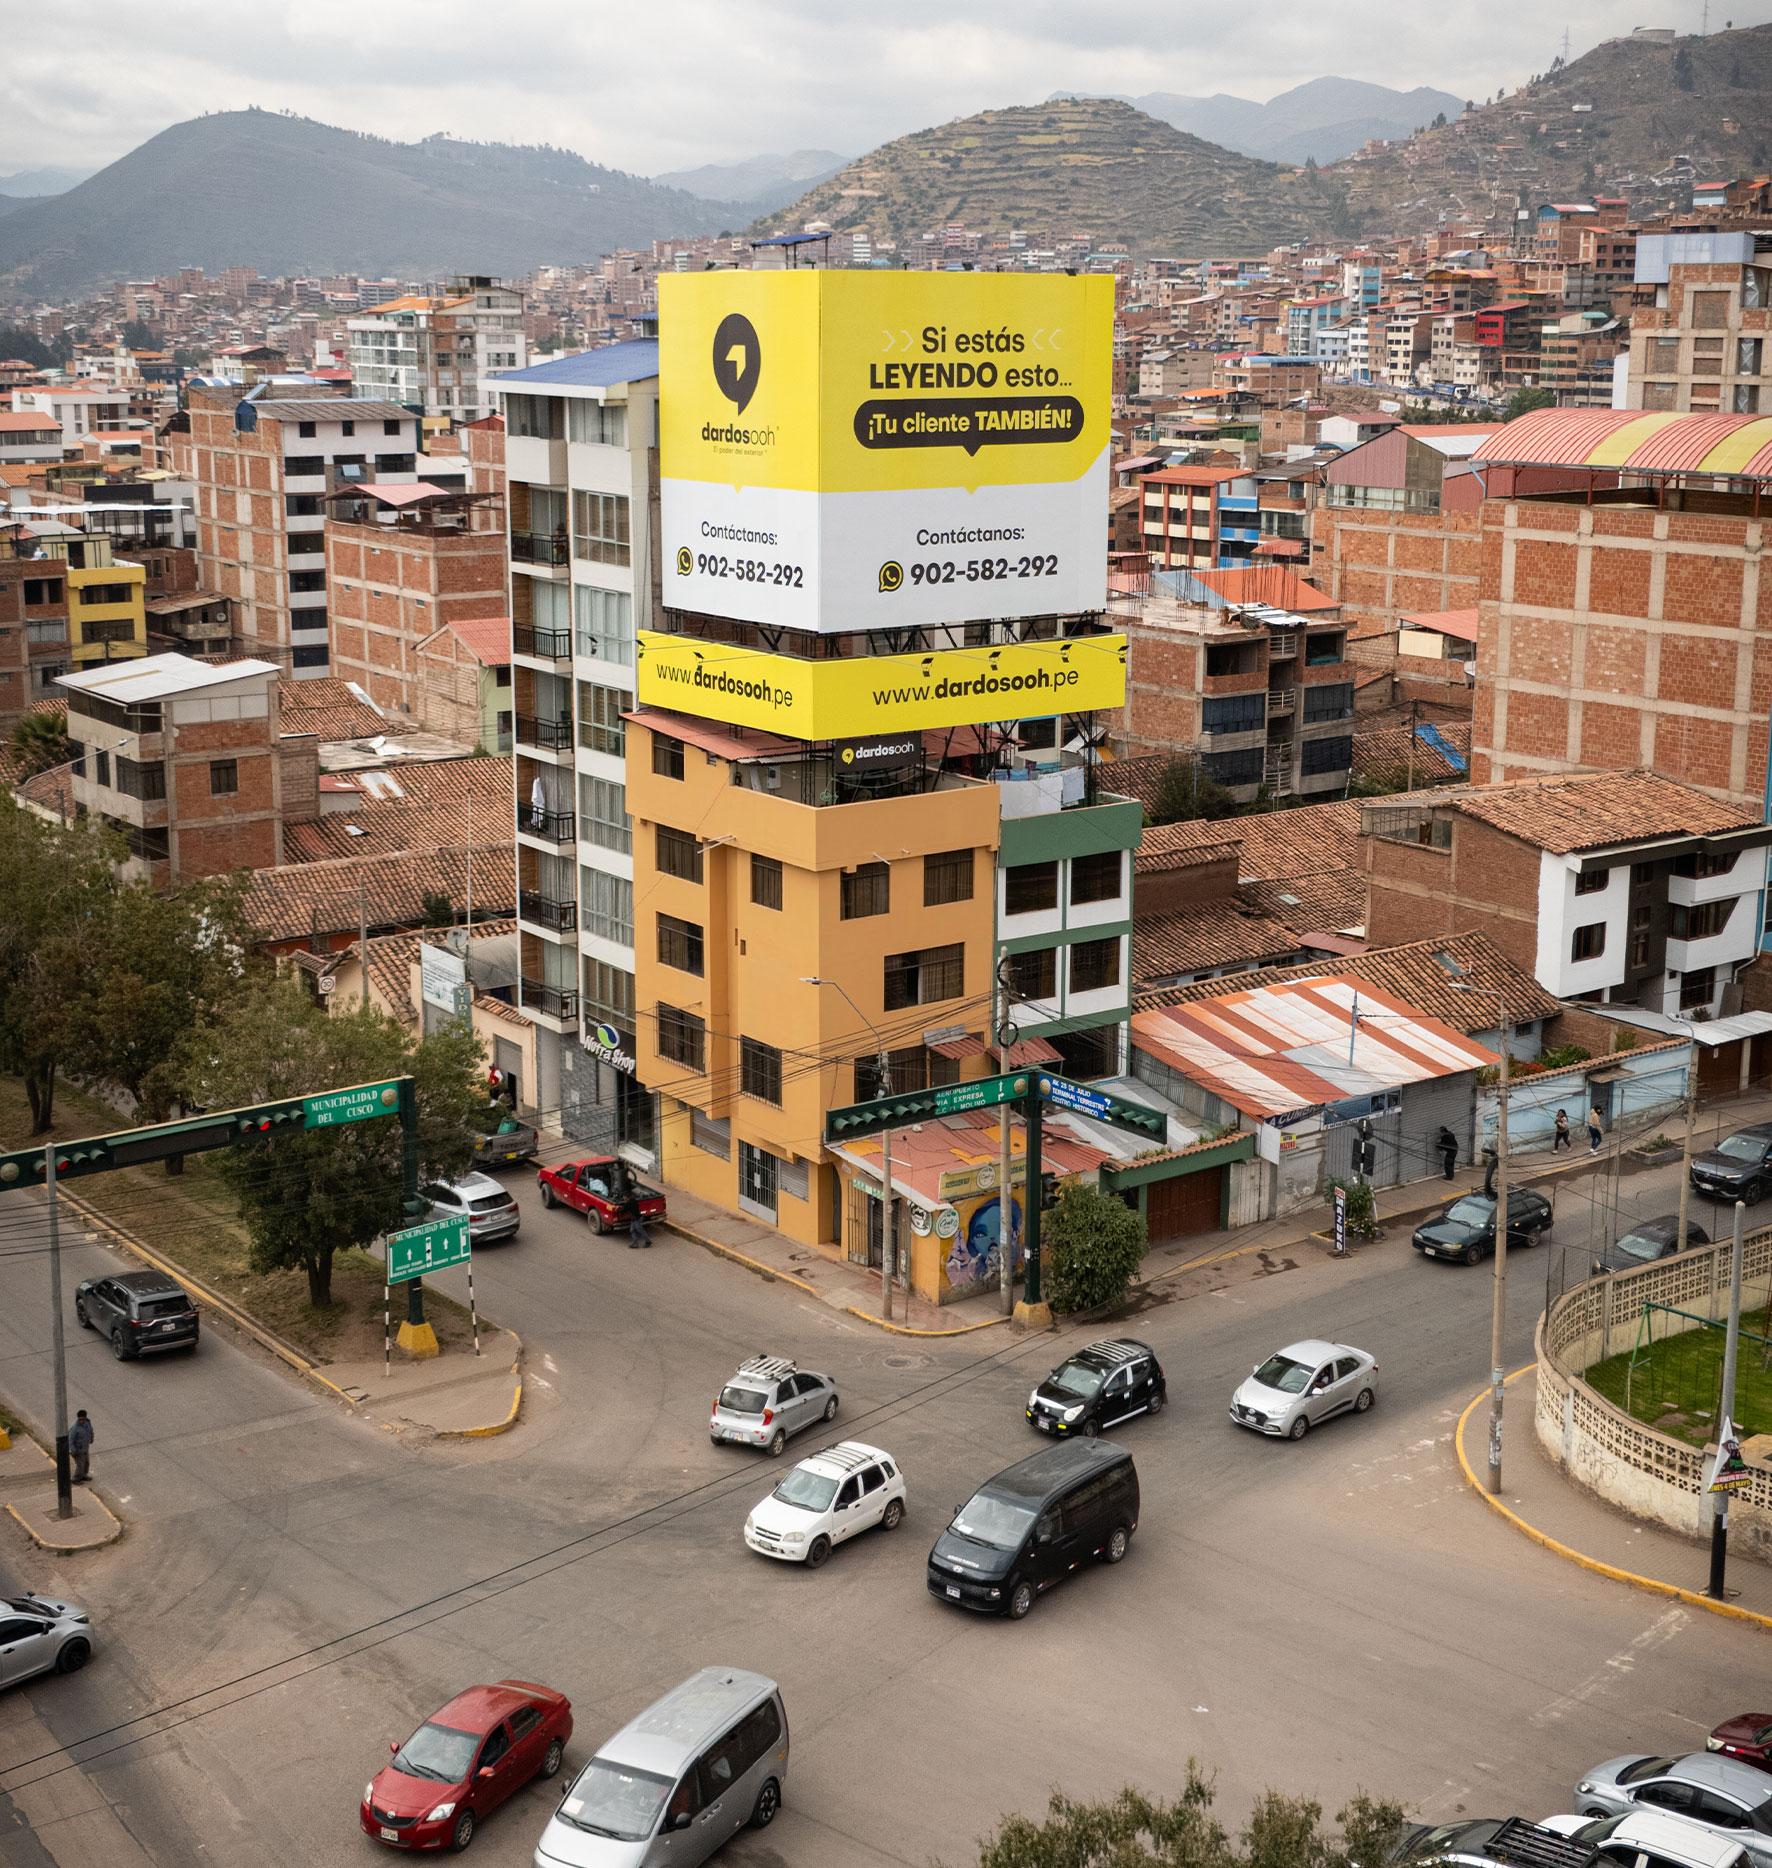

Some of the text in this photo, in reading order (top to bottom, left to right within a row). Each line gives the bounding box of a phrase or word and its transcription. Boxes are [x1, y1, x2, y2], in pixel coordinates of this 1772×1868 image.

[922, 326, 1025, 353] Si estás
[870, 362, 1072, 389] LEYENDO esto...
[701, 421, 775, 446] dardosooh
[868, 403, 1072, 440] ¡Tu cliente TAMBIÉN!
[713, 445, 719, 453] El
[701, 520, 778, 545] Contáctanos:
[916, 526, 1025, 546] Contáctanos:
[697, 553, 803, 588] 902-582-292
[910, 554, 1058, 586] 902-582-292
[656, 663, 793, 709] www.dardosooh.pe
[872, 668, 1079, 705] www.dardosooh.pe
[855, 741, 914, 759] dardosooh
[584, 1035, 612, 1060] Nutra
[612, 1049, 636, 1074] Shop
[311, 1090, 378, 1112] MUNICIPALIDAD
[936, 1084, 980, 1098] AEROPUERTO
[953, 1092, 984, 1103] EXPRESA
[1052, 1087, 1105, 1111] TERMINAL TERRESTRE
[1068, 1084, 1075, 1092] DE
[1076, 1087, 1091, 1098] JULIO
[318, 1104, 374, 1124] DEL CUSCO
[960, 1099, 986, 1110] MOLINO
[1051, 1095, 1099, 1117] CENTRO HISTORICO
[395, 1215, 469, 1241] MUNICIPALIDAD DEL CUSCO
